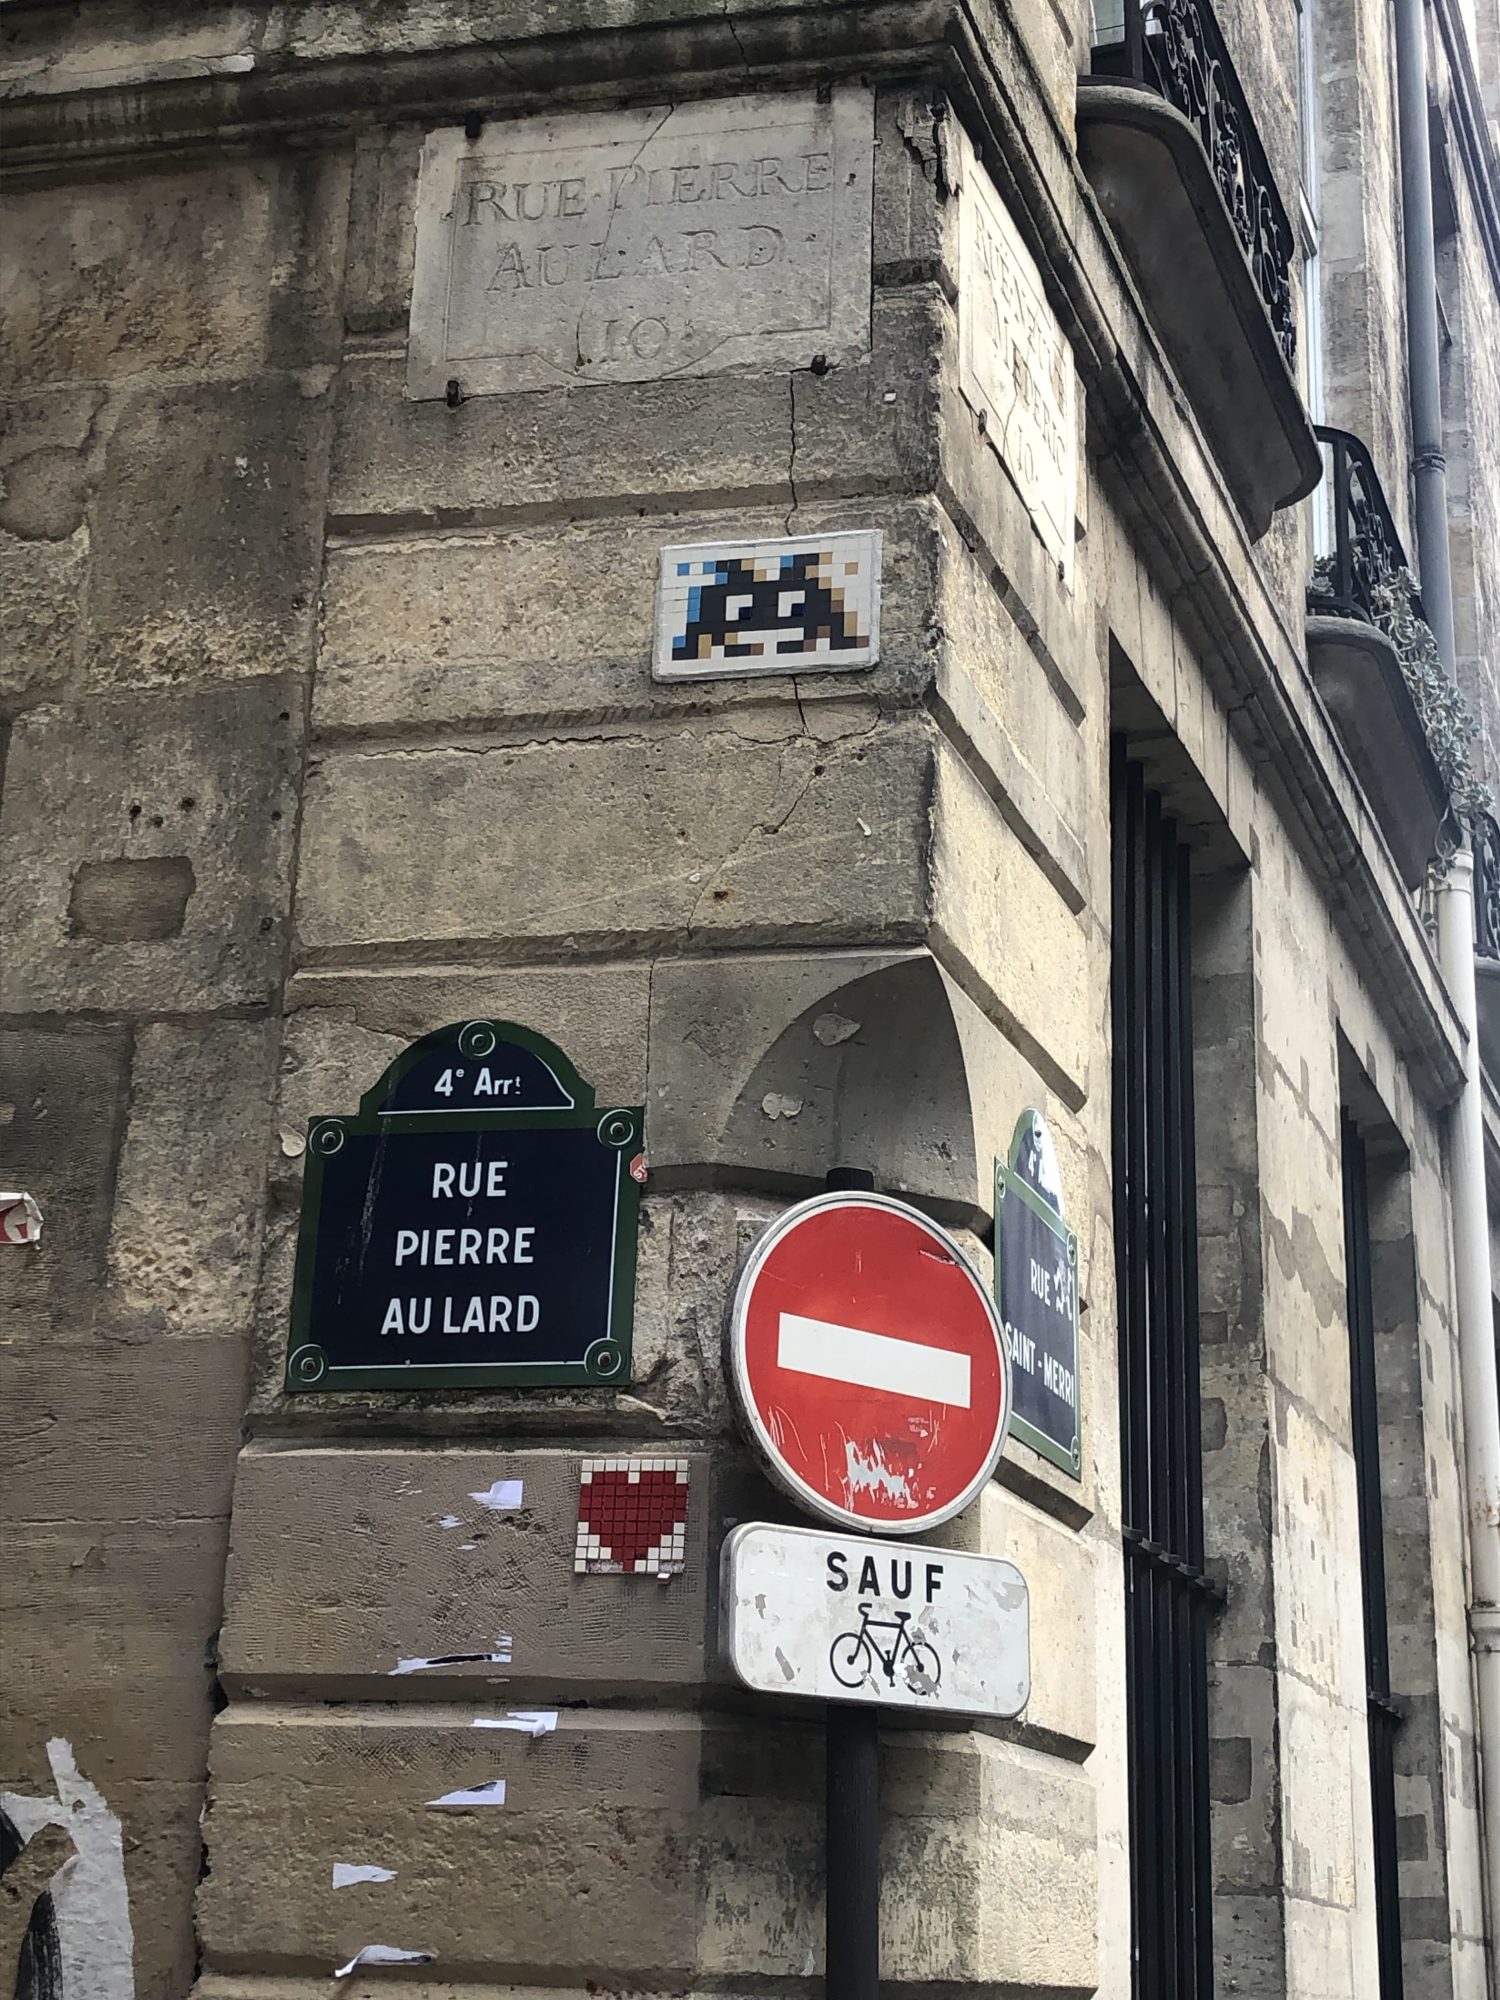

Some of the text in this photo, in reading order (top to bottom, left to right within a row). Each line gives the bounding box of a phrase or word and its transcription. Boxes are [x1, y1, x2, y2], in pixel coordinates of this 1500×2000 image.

[460, 152, 831, 227] RUE PIERRE
[432, 1161, 508, 1198] RUE
[394, 1226, 536, 1266] PIERRE
[1030, 1257, 1051, 1307] RUE
[826, 1551, 944, 1603] SAUF
